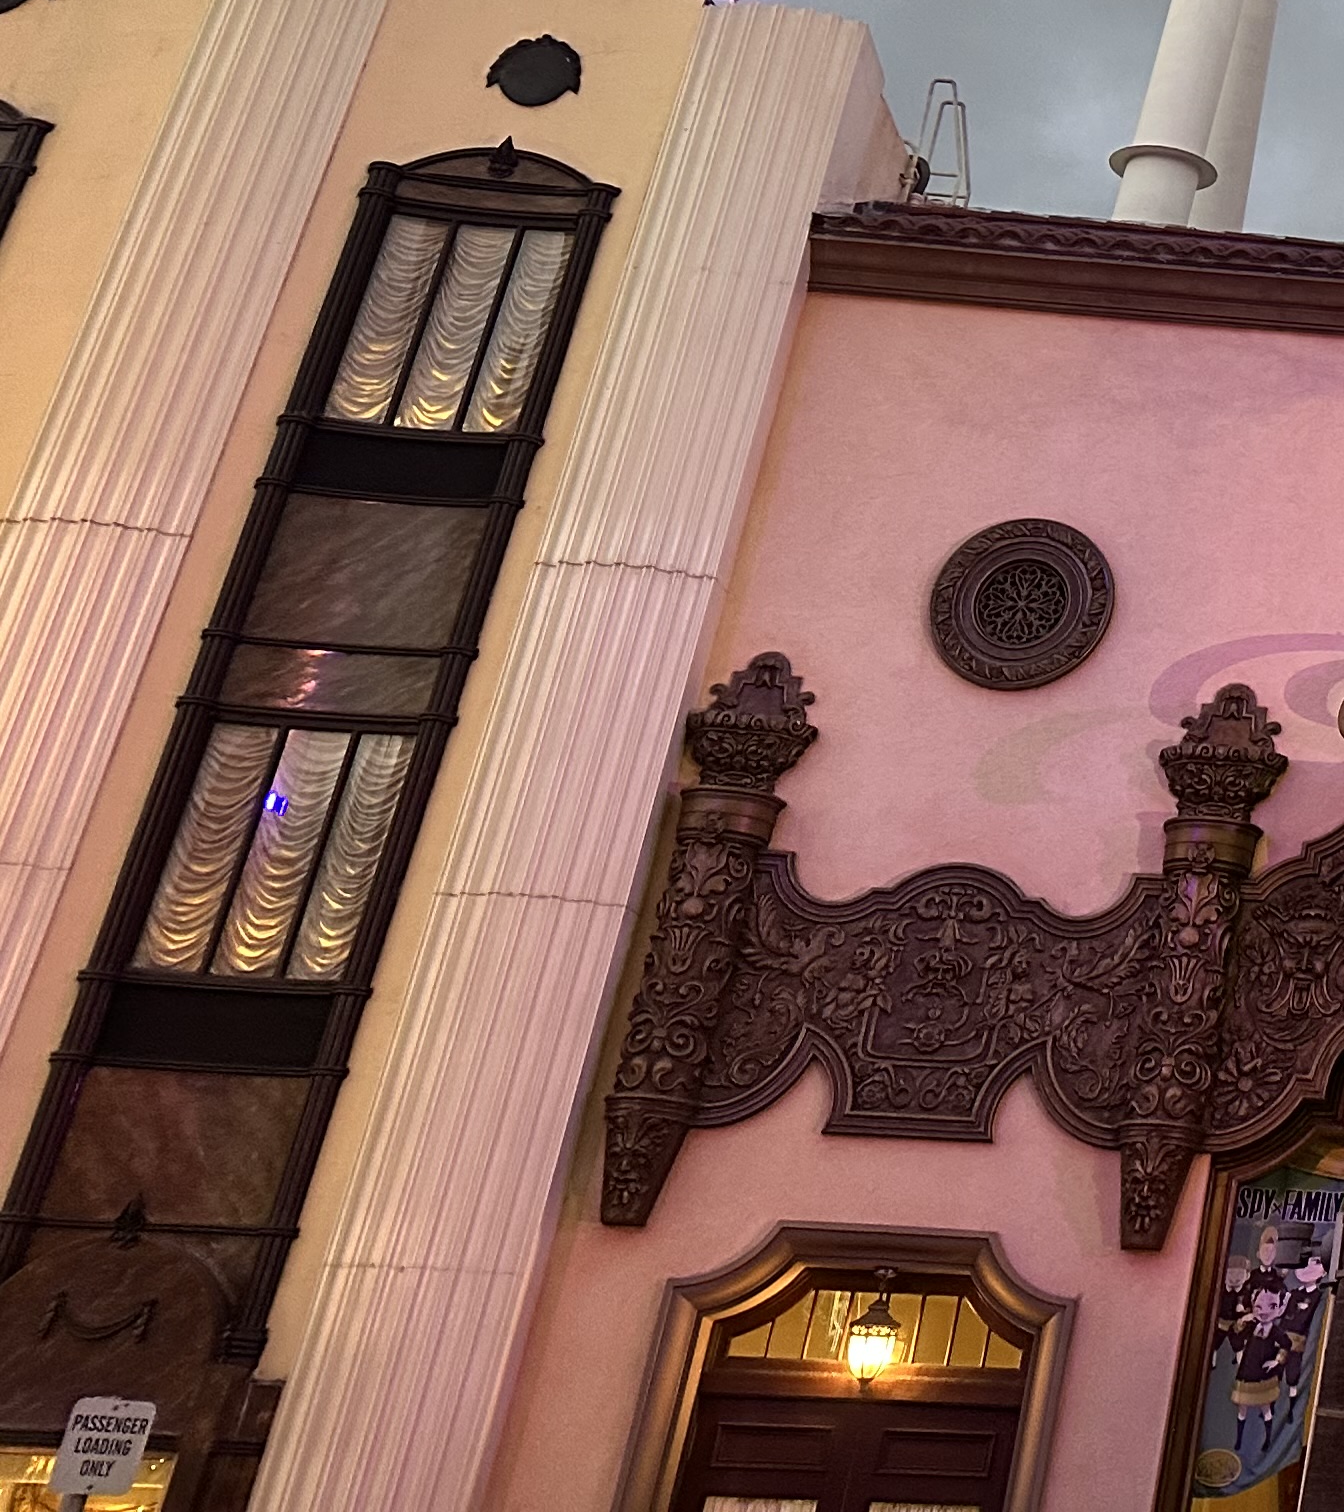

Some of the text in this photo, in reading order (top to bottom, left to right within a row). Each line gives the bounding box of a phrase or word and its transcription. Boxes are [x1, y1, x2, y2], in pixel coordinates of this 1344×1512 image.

[72, 1415, 149, 1434] PASSENGER
[74, 1438, 132, 1456] LOADING
[79, 1460, 115, 1476] ONLY
